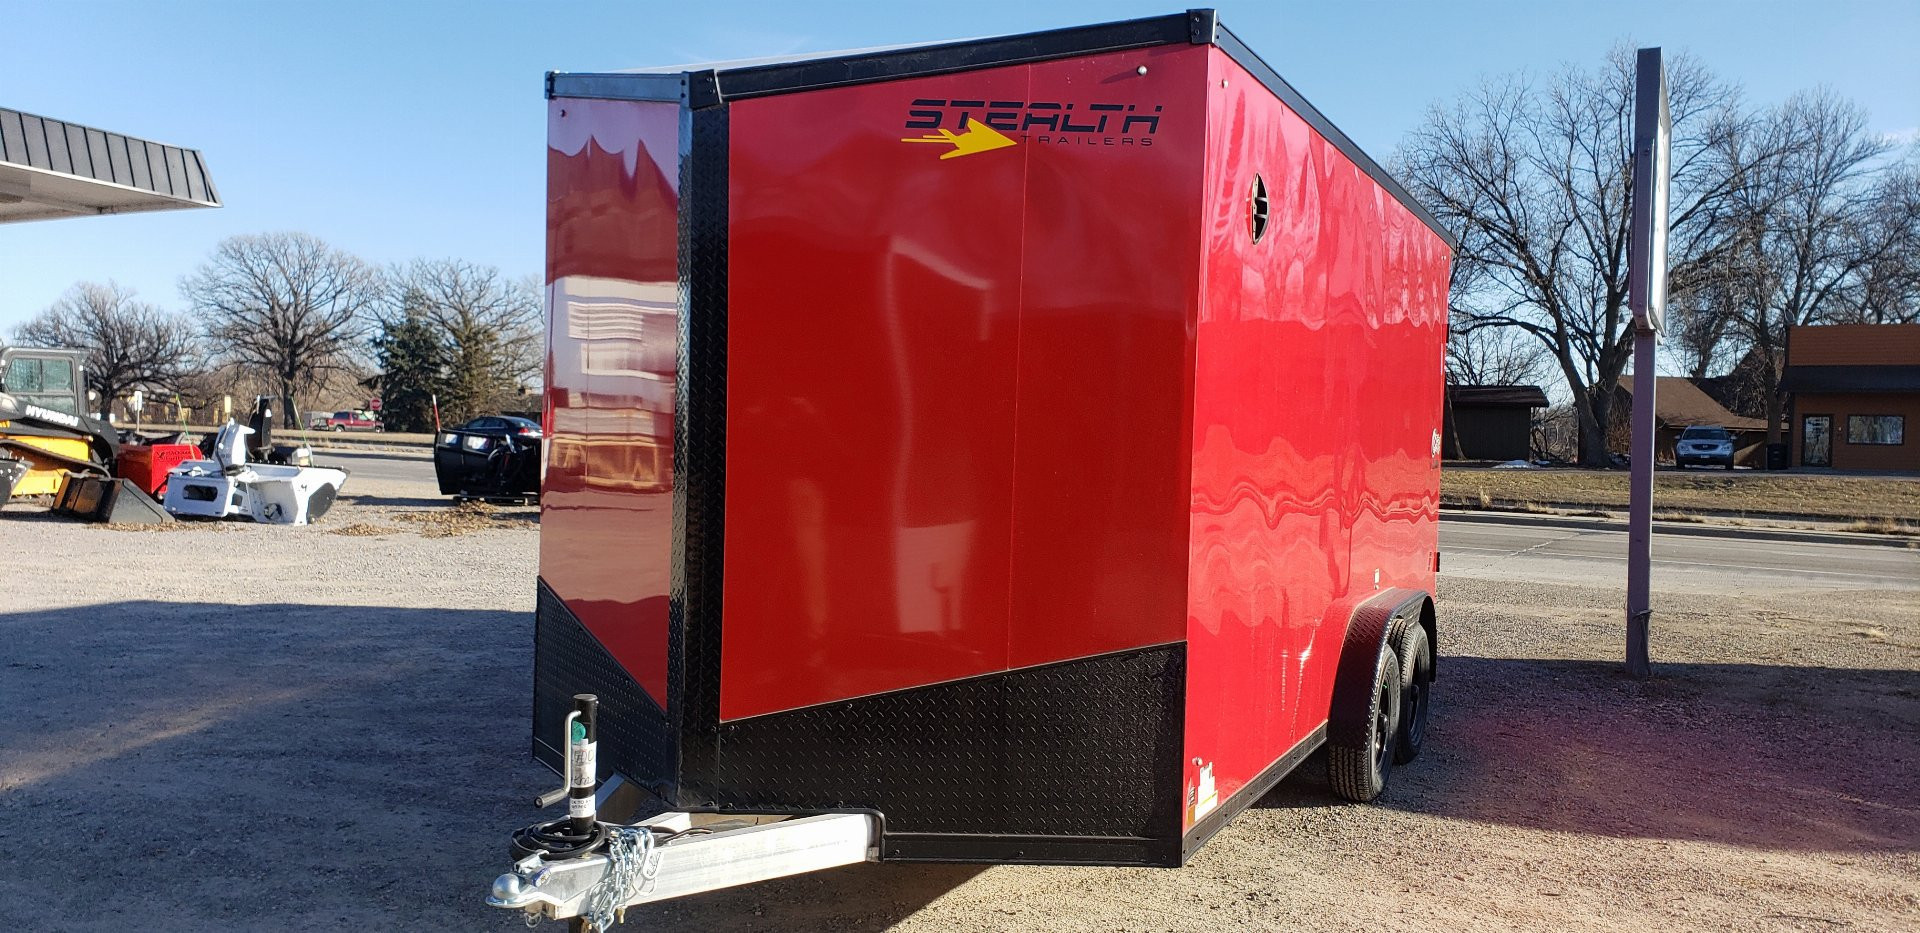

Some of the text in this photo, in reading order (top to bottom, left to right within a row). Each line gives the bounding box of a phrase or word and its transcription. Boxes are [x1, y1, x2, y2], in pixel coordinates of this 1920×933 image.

[905, 98, 1163, 134] STEALTH
[1020, 134, 1153, 147] TRAILERS
[25, 404, 79, 427] HYUNDAI
